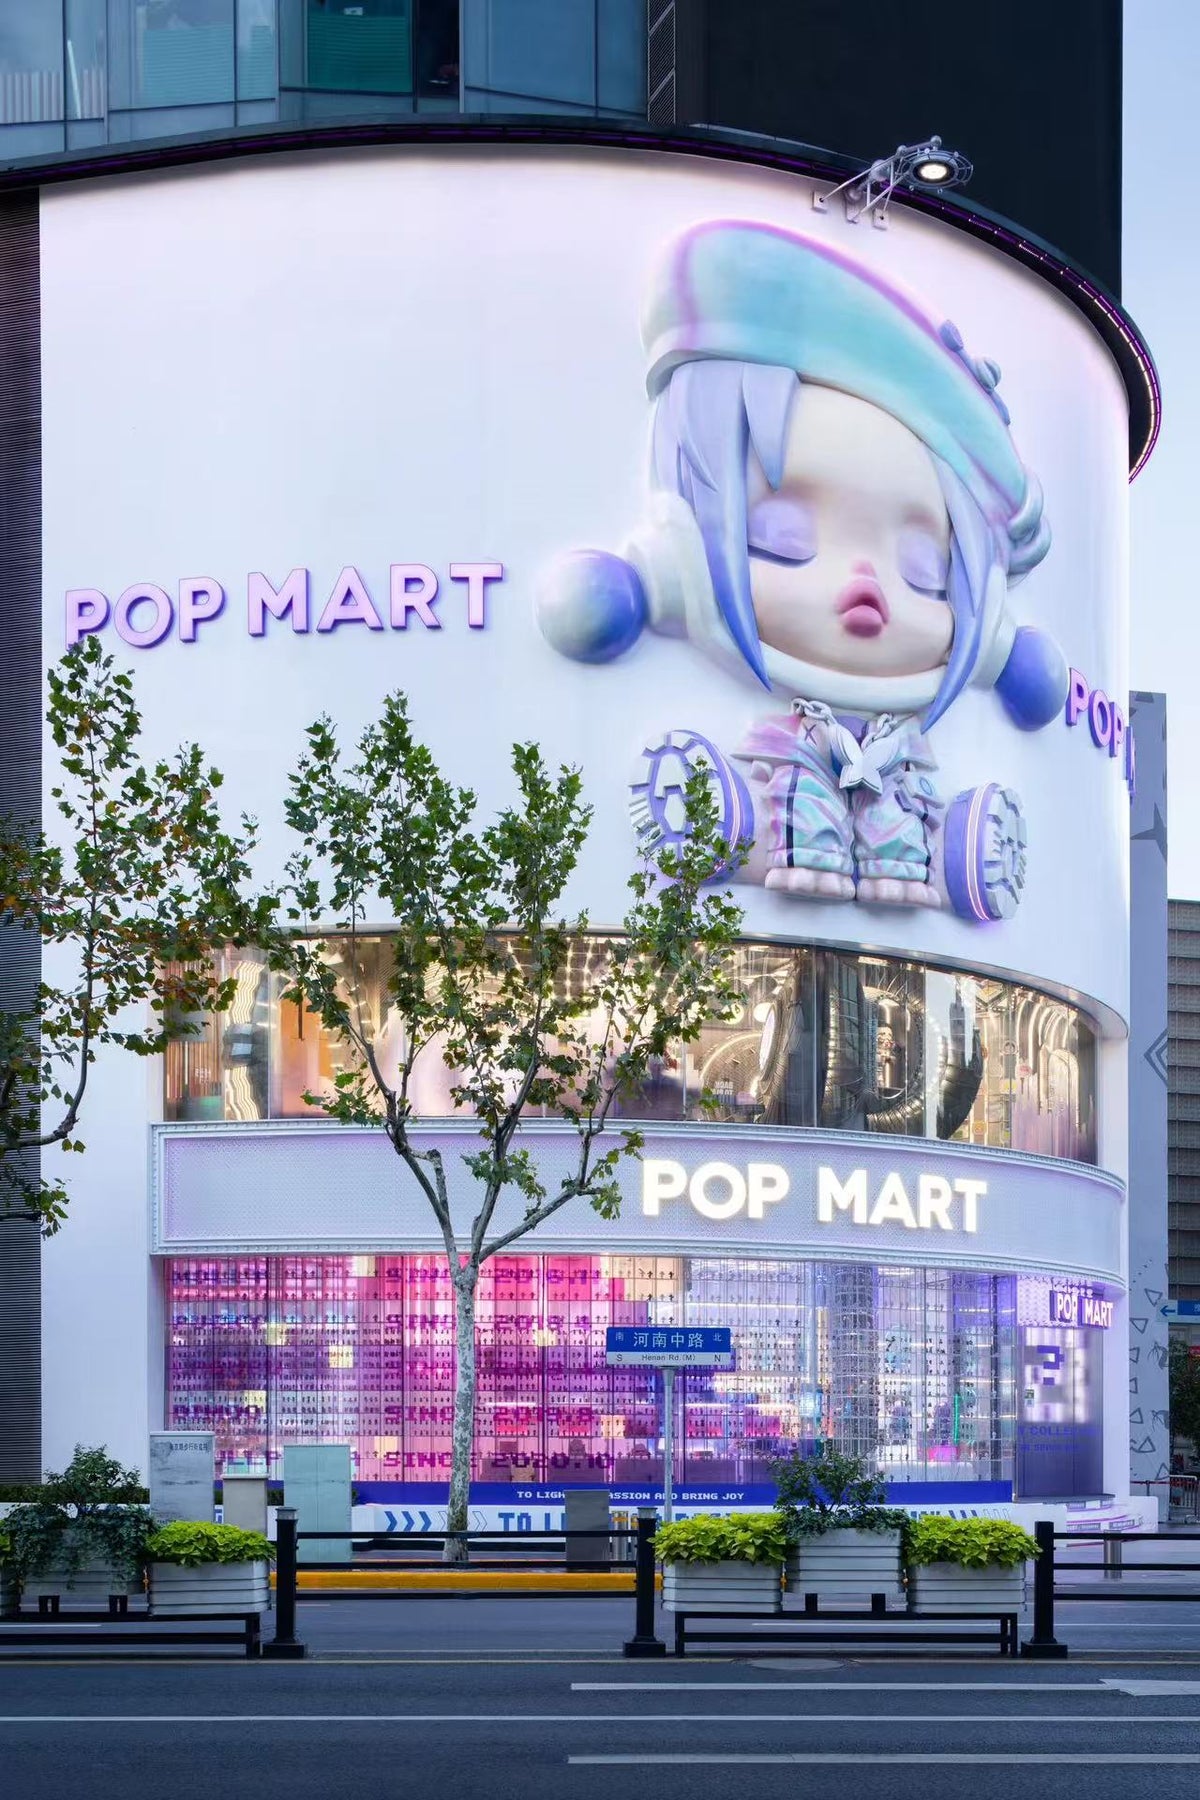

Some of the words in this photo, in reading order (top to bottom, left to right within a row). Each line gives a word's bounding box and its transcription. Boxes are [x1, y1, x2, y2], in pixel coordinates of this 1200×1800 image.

[66, 576, 225, 649] POP
[248, 562, 503, 637] MART
[1065, 667, 1124, 757] POP
[642, 1159, 790, 1220] POP
[817, 1166, 988, 1233] MART
[1057, 1292, 1079, 1321] POP
[1085, 1298, 1113, 1327] MART
[615, 1331, 624, 1341] 南
[633, 1331, 704, 1348] 河南中路
[713, 1332, 722, 1341] 北
[616, 1354, 623, 1362] S
[714, 1354, 721, 1362] N
[491, 1452, 614, 1468] 2020.10
[654, 1492, 678, 1500] AD
[682, 1492, 718, 1500] BRING
[722, 1492, 744, 1500] JOY
